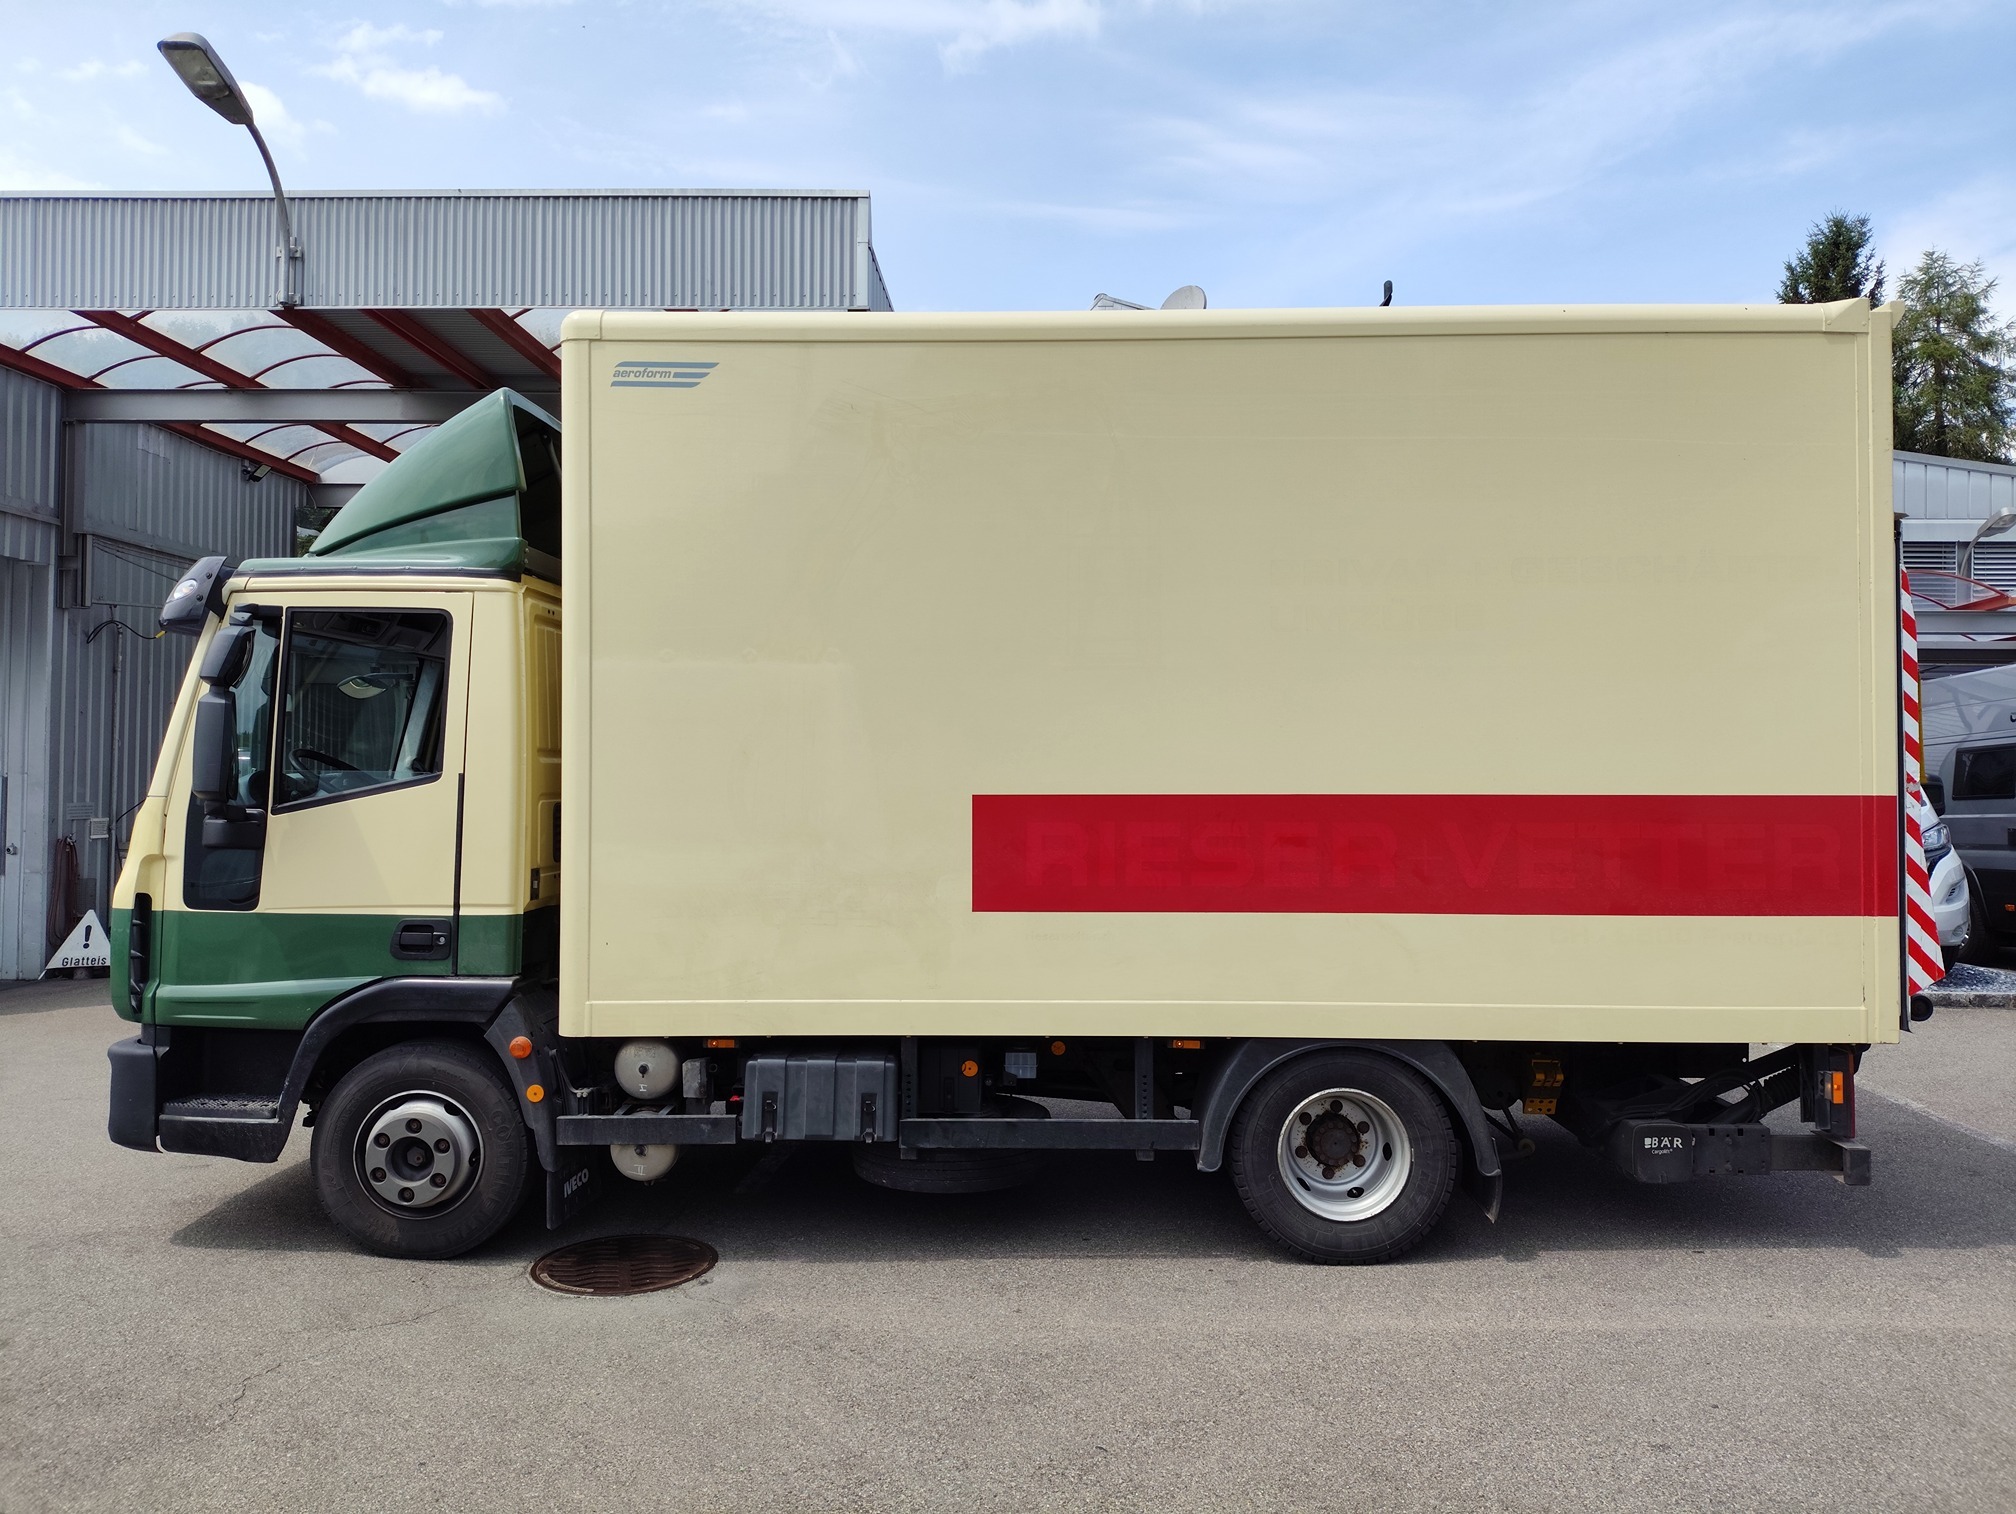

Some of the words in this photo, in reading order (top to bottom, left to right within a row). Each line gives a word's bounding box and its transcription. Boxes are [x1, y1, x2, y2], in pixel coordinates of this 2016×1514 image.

[613, 367, 672, 379] aeroform
[61, 956, 107, 967] Glatteis
[1651, 1137, 1683, 1149] BÄR
[564, 1168, 589, 1199] IVECO
